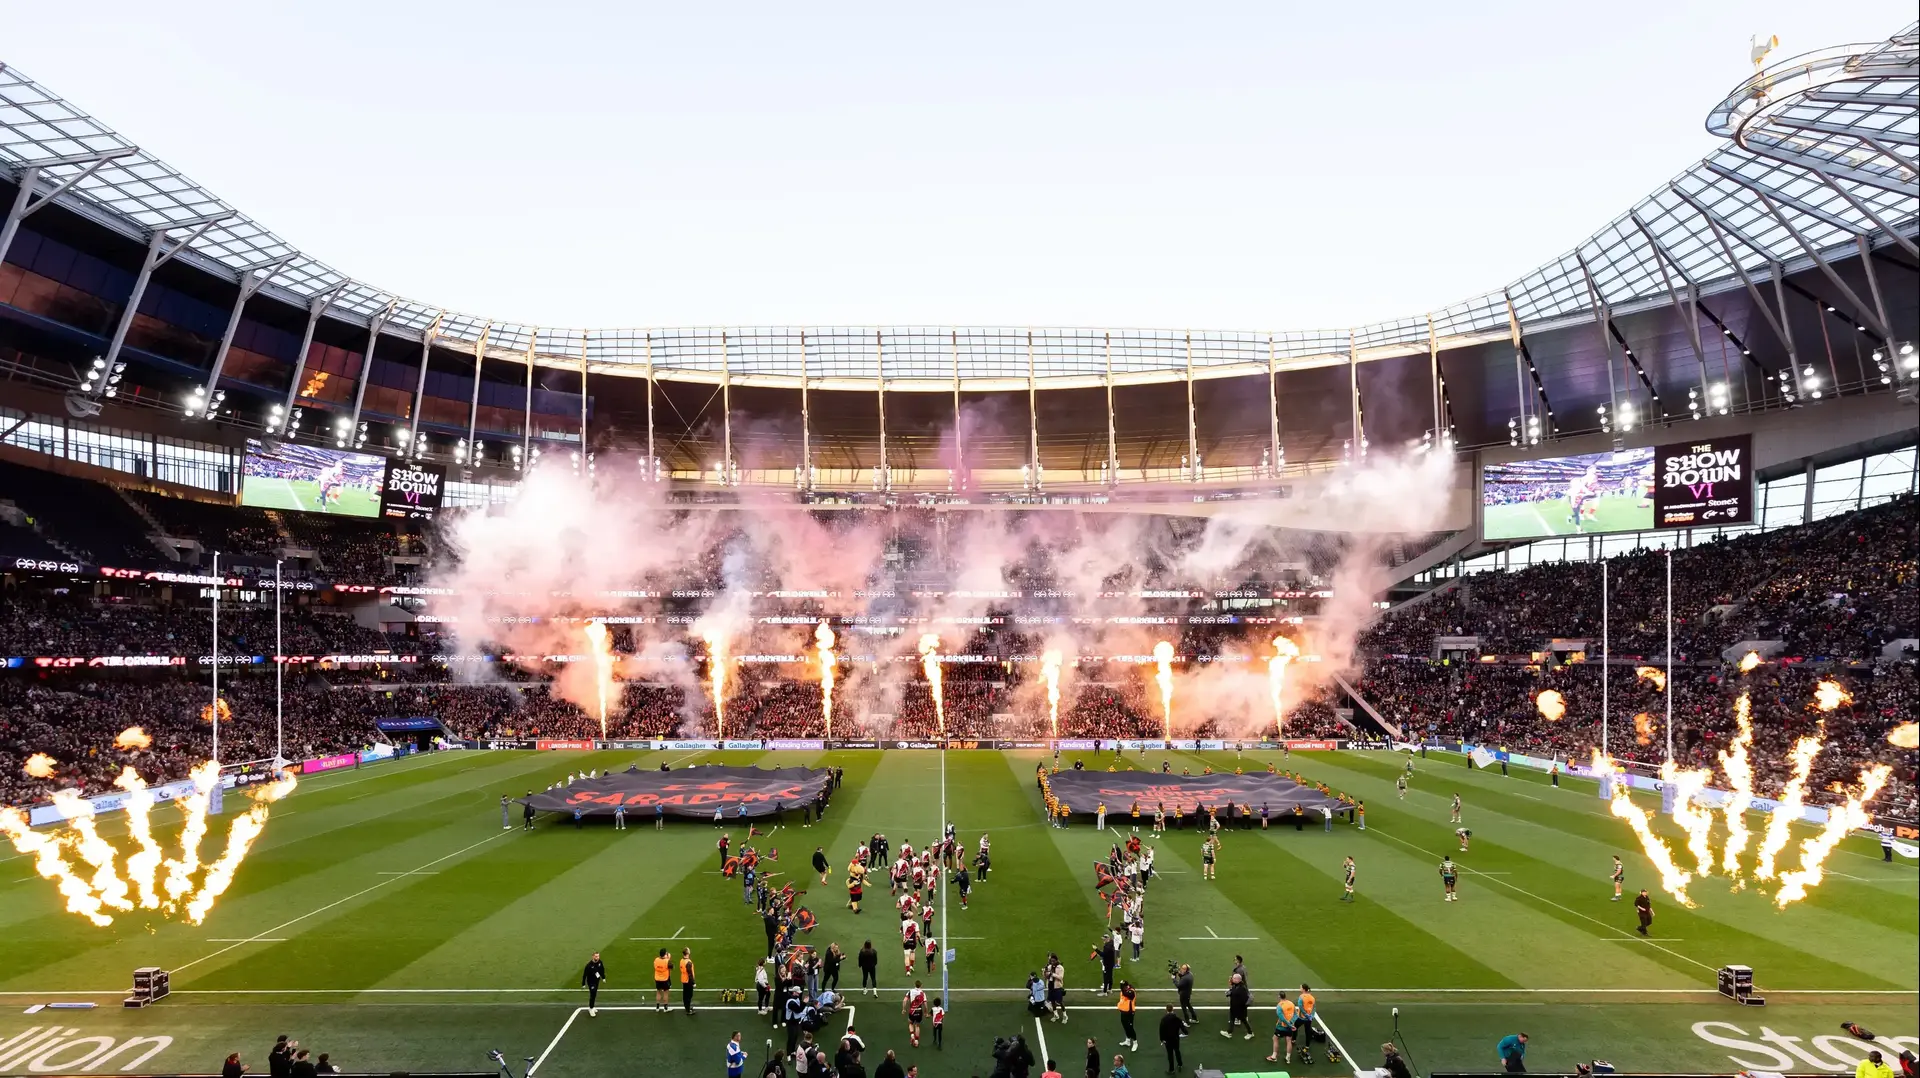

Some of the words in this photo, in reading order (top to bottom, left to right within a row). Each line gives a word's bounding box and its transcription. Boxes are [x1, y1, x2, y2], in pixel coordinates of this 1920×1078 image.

[1691, 444, 1712, 453] THE
[1665, 449, 1740, 472] SHOW
[391, 468, 439, 485] SHOW
[1663, 465, 1740, 487] DOWN
[389, 479, 437, 496] DOWN
[1688, 483, 1713, 499] VI
[405, 492, 420, 504] VI
[1708, 498, 1739, 507] StoneX
[675, 740, 706, 749] Gallagher
[728, 741, 759, 749] Gallagher
[776, 740, 800, 749] Funding
[801, 740, 820, 748] Circle
[1060, 741, 1085, 749] Funding
[566, 786, 803, 805] SARACENS
